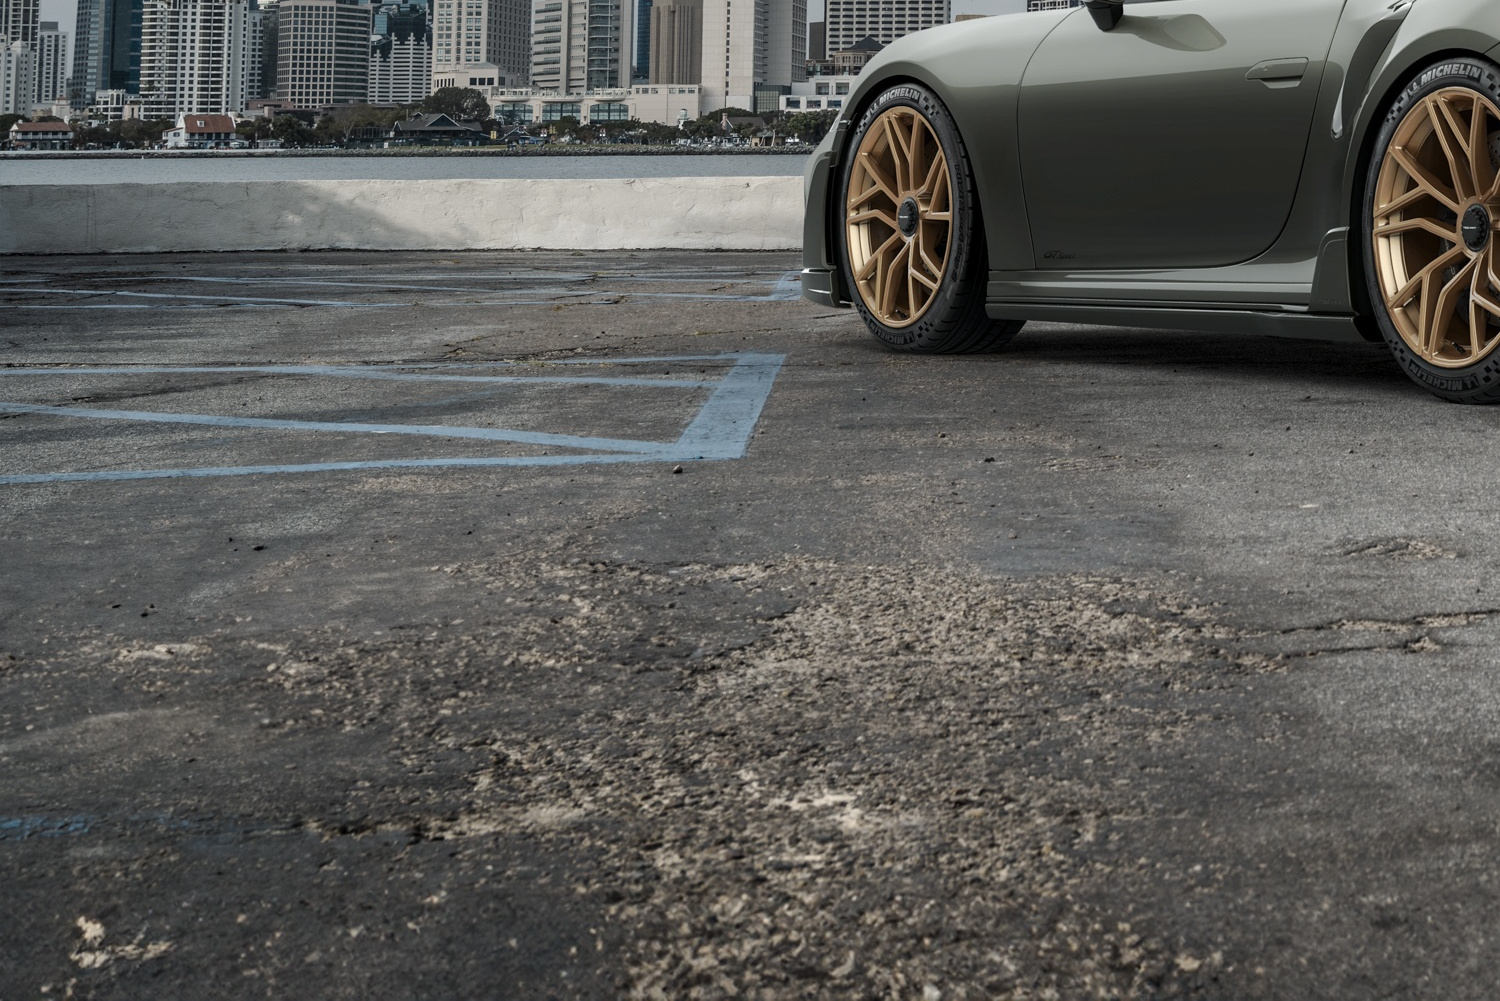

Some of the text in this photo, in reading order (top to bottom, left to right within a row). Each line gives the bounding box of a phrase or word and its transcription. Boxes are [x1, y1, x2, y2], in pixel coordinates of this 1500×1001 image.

[1420, 63, 1482, 85] MICHELIN
[879, 87, 920, 105] MICHELIN
[869, 321, 905, 345] MICHELIN
[1409, 361, 1463, 391] MICHELIN
